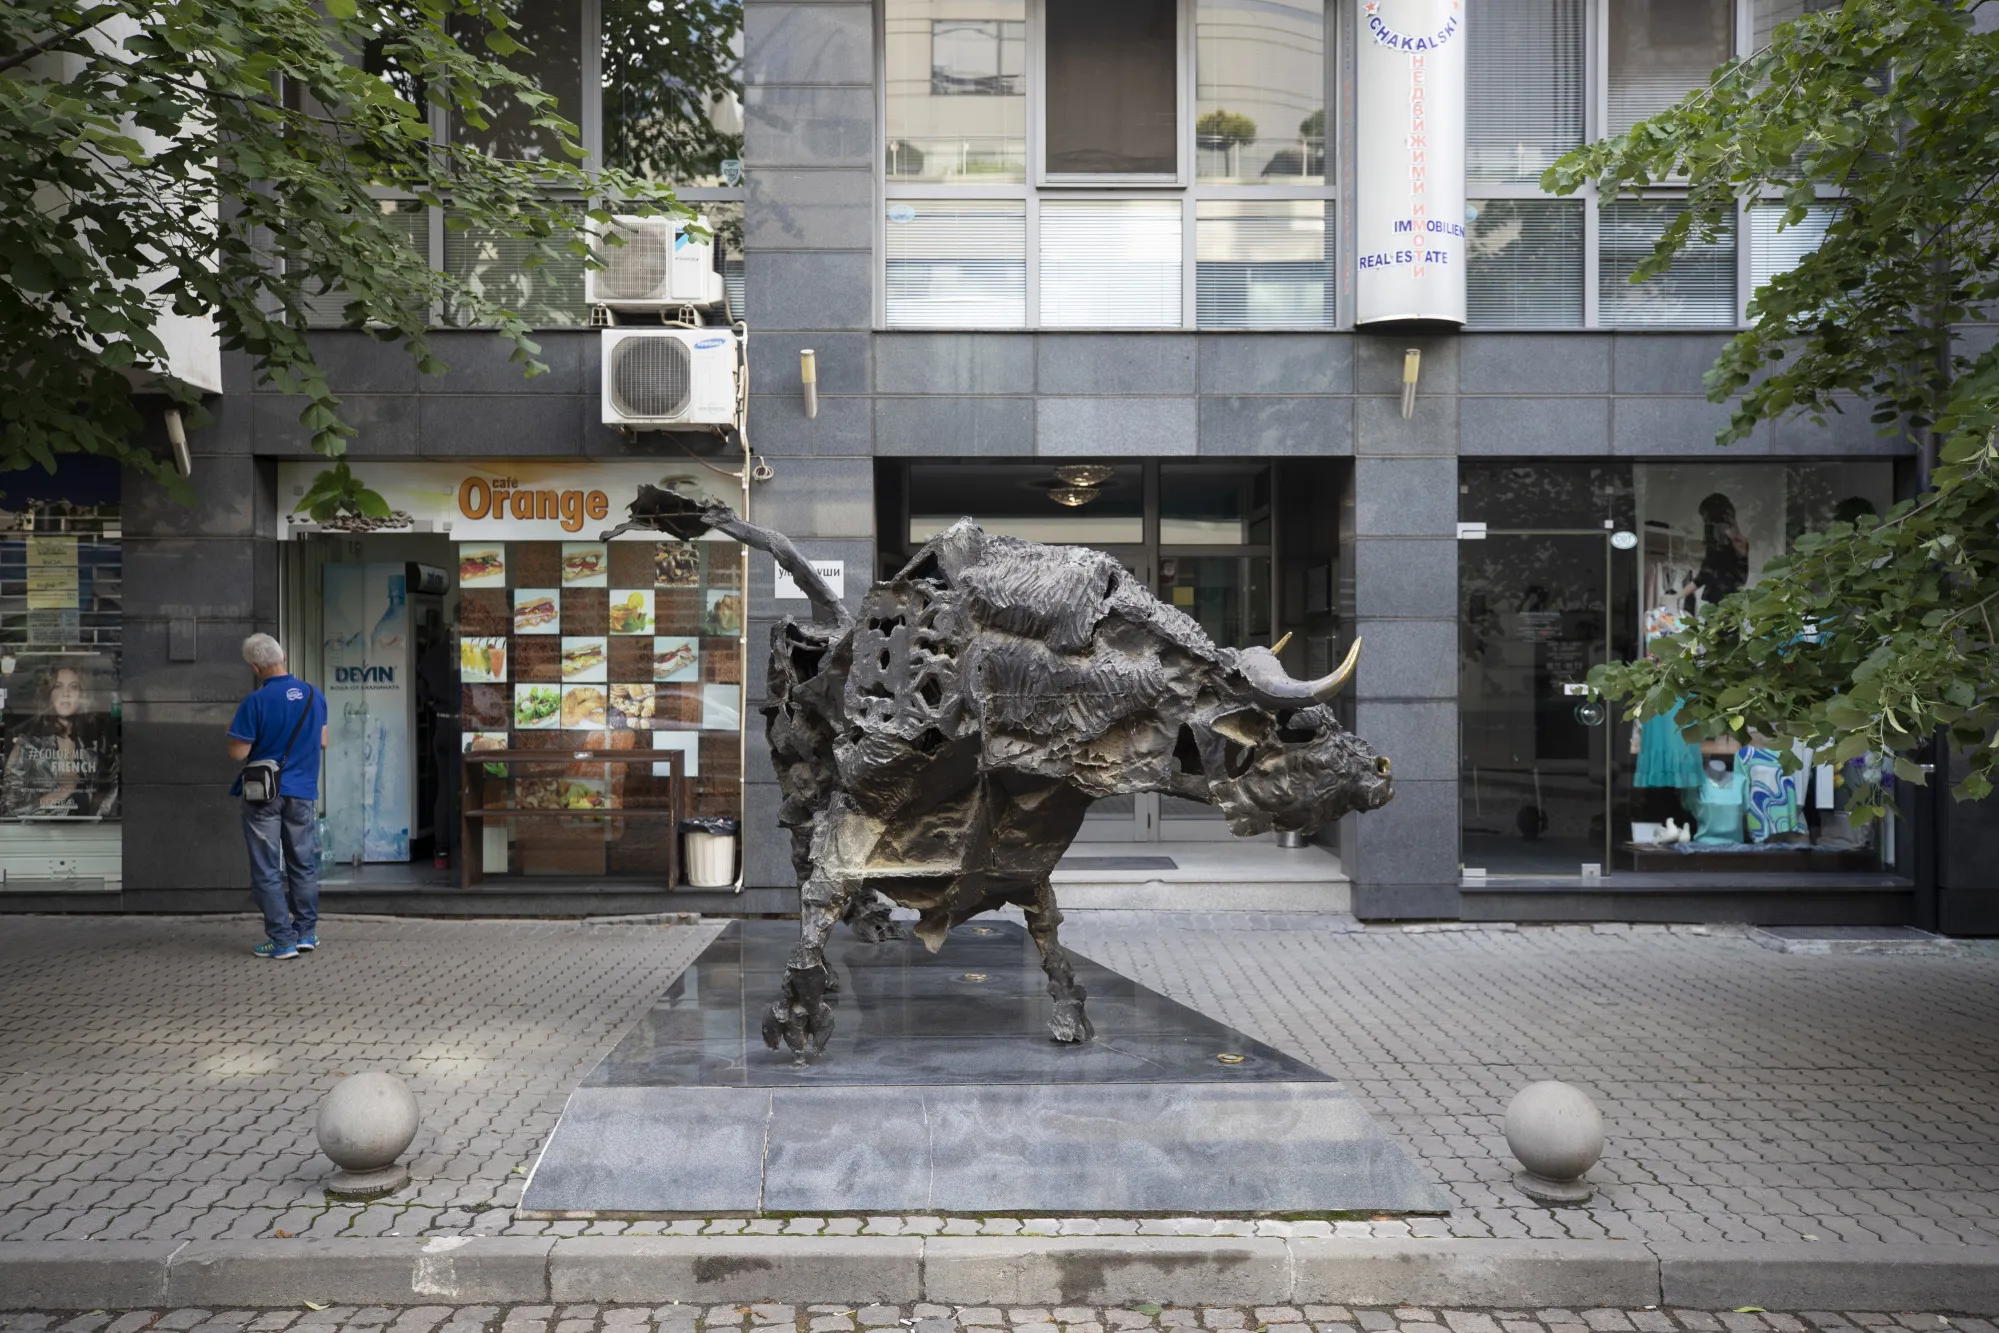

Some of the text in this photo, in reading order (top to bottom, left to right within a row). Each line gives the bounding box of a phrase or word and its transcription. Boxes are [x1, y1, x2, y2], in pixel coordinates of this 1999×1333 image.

[1370, 16, 1457, 50] CHAKALSKI
[1410, 55, 1427, 278] НЕДВИЖИМИ ИМОТИ
[1394, 219, 1465, 238] IMMOBILIEN
[1359, 250, 1448, 269] REAL ESTATE
[492, 476, 518, 489] café
[458, 476, 609, 533] Orange
[335, 666, 394, 683] DEVIN
[28, 748, 69, 760] #COLOR
[51, 761, 96, 773] FRENCH
